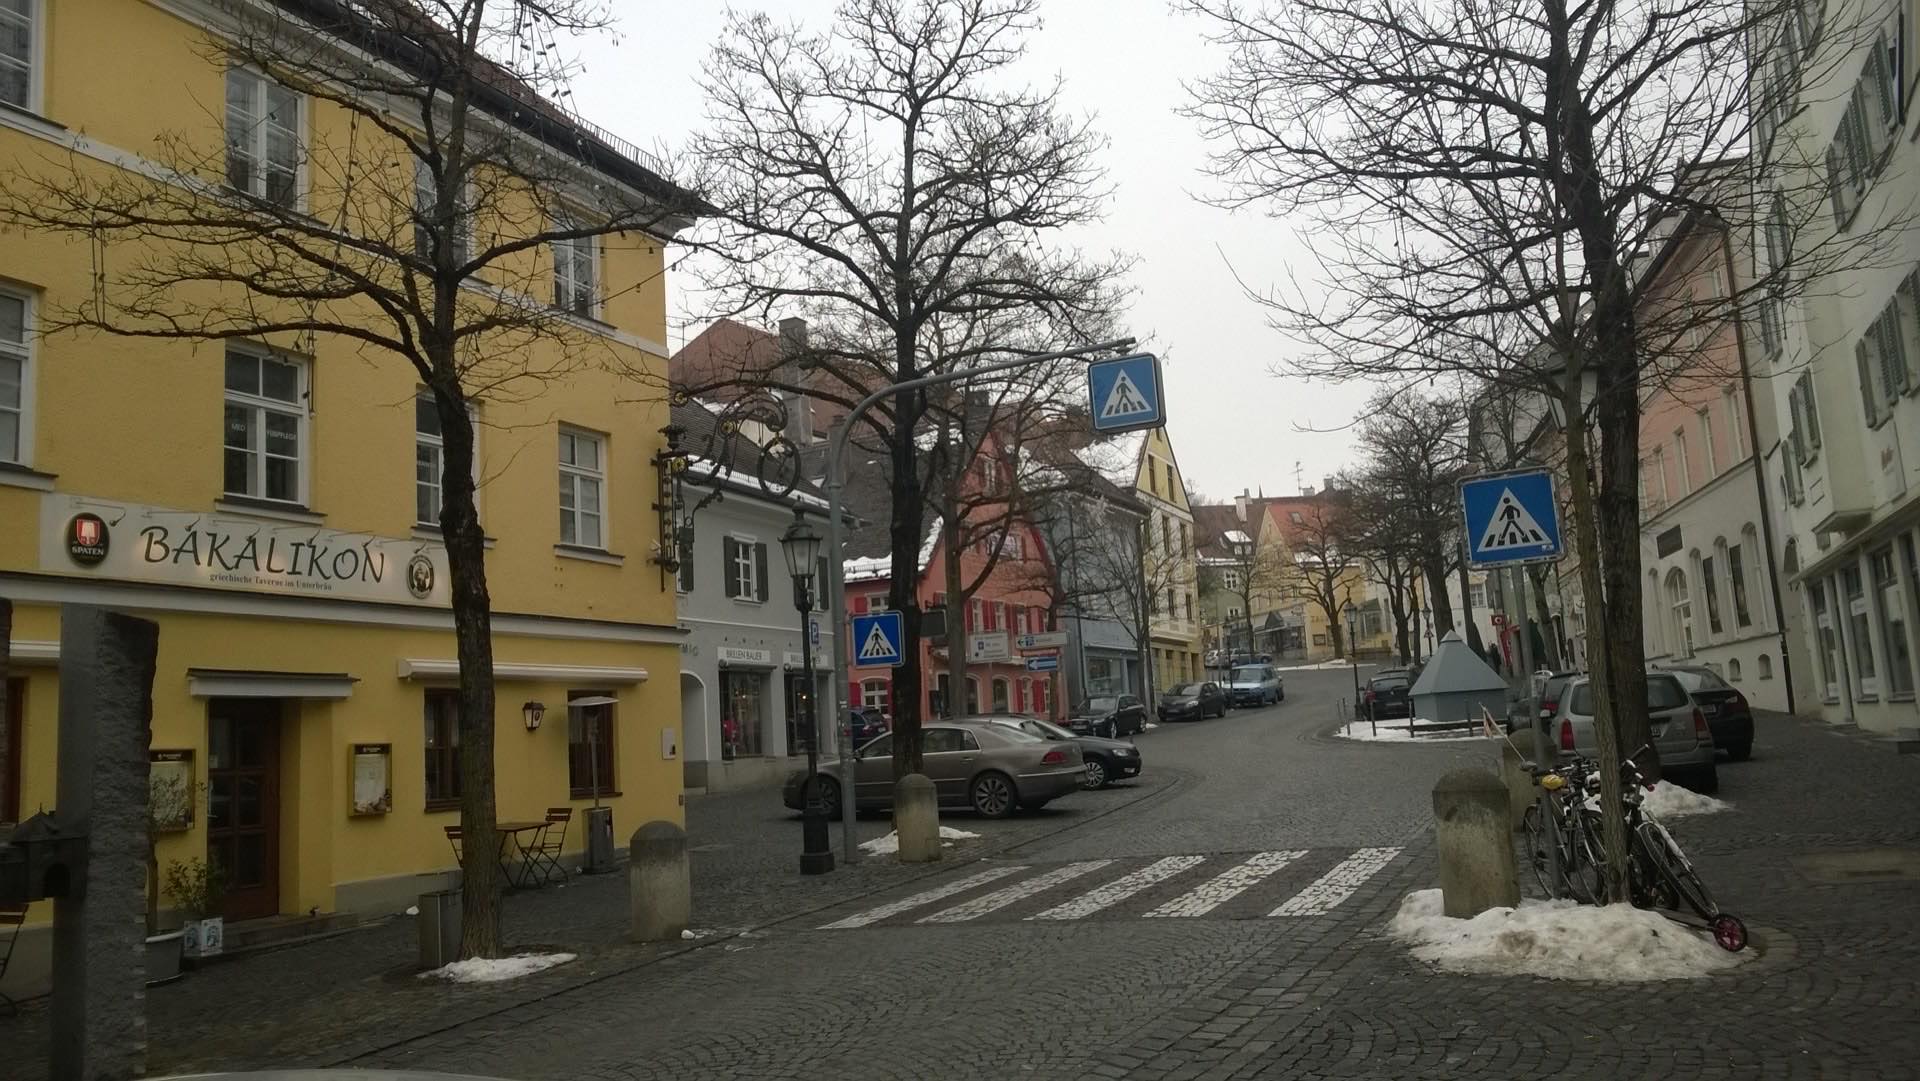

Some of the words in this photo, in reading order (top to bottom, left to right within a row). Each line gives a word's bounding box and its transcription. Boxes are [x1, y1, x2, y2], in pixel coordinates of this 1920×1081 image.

[71, 545, 104, 555] SPATEN
[209, 573, 252, 584] griechische
[255, 576, 283, 586] Taverne
[285, 579, 294, 587] im
